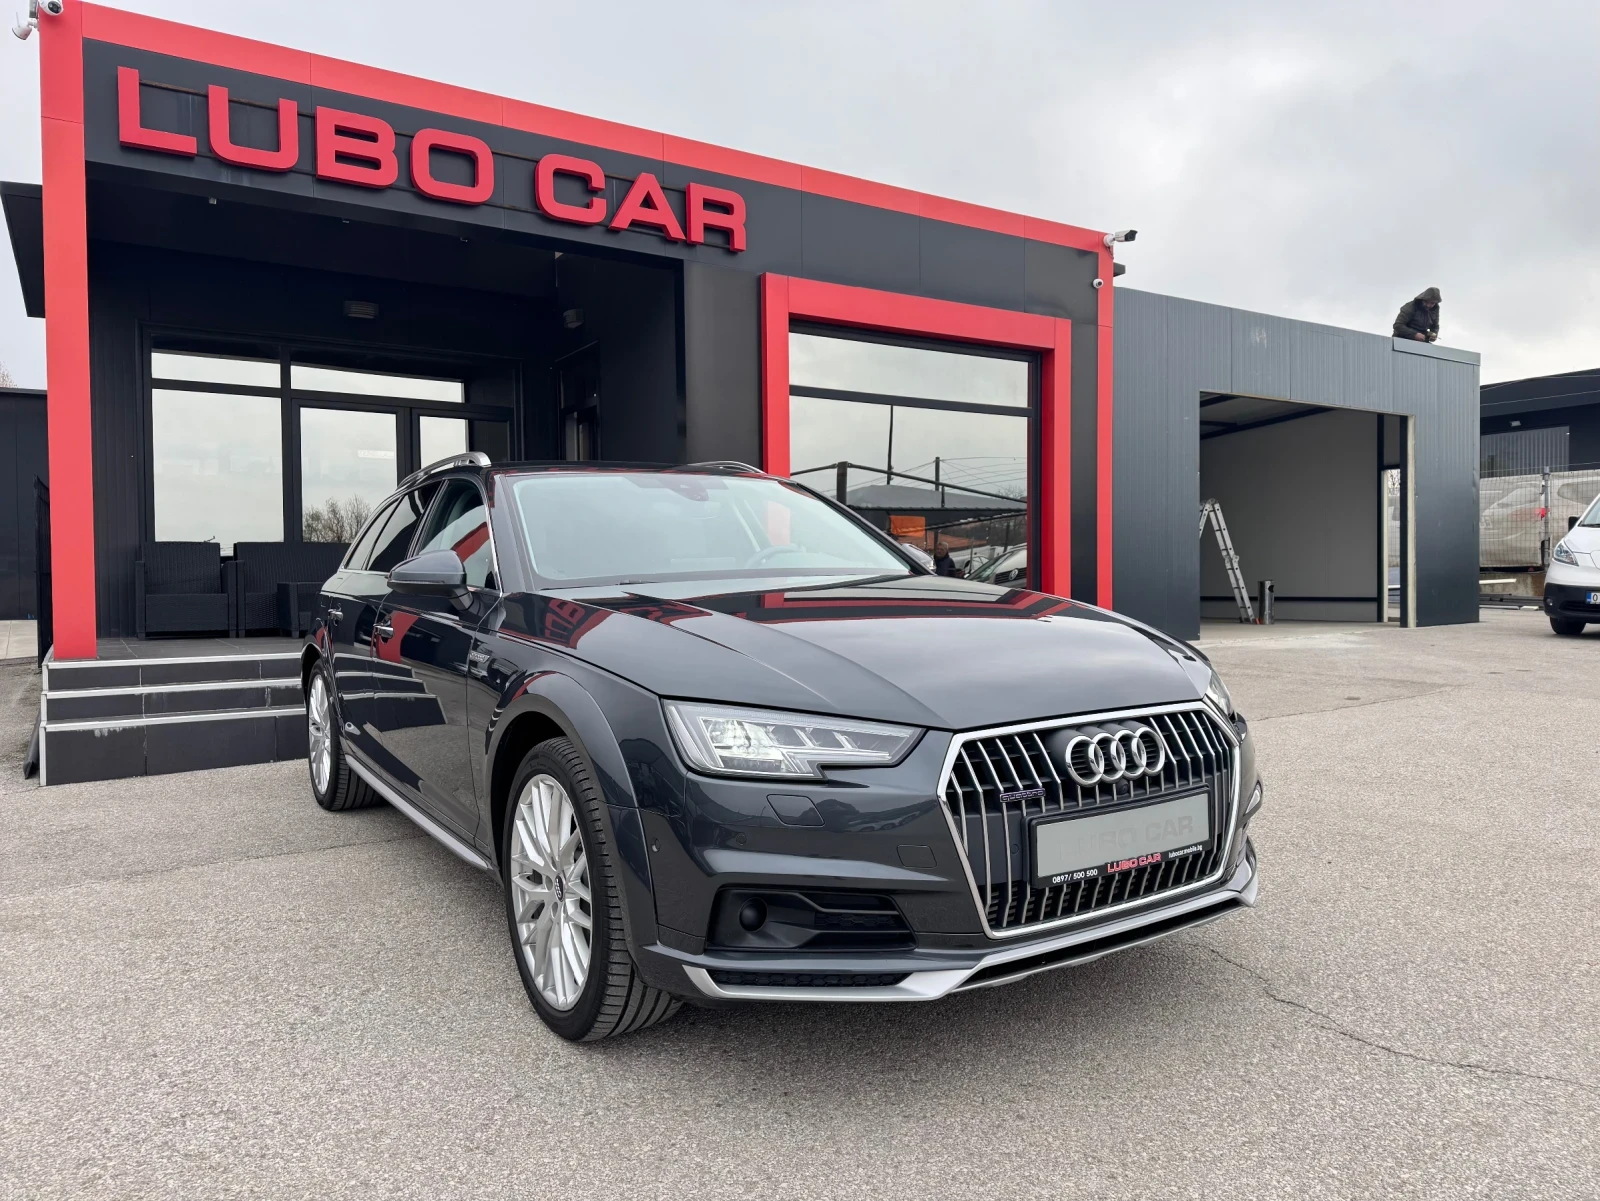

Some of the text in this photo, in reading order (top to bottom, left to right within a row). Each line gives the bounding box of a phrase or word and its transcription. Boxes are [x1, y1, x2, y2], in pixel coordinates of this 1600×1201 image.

[117, 66, 748, 253] LUBO CAR
[1145, 815, 1194, 843] CAR
[1052, 873, 1072, 884] 0897/
[1073, 871, 1085, 880] 500
[1086, 868, 1098, 878] 500
[1107, 858, 1138, 873] LUBO
[1139, 852, 1162, 866] CAR
